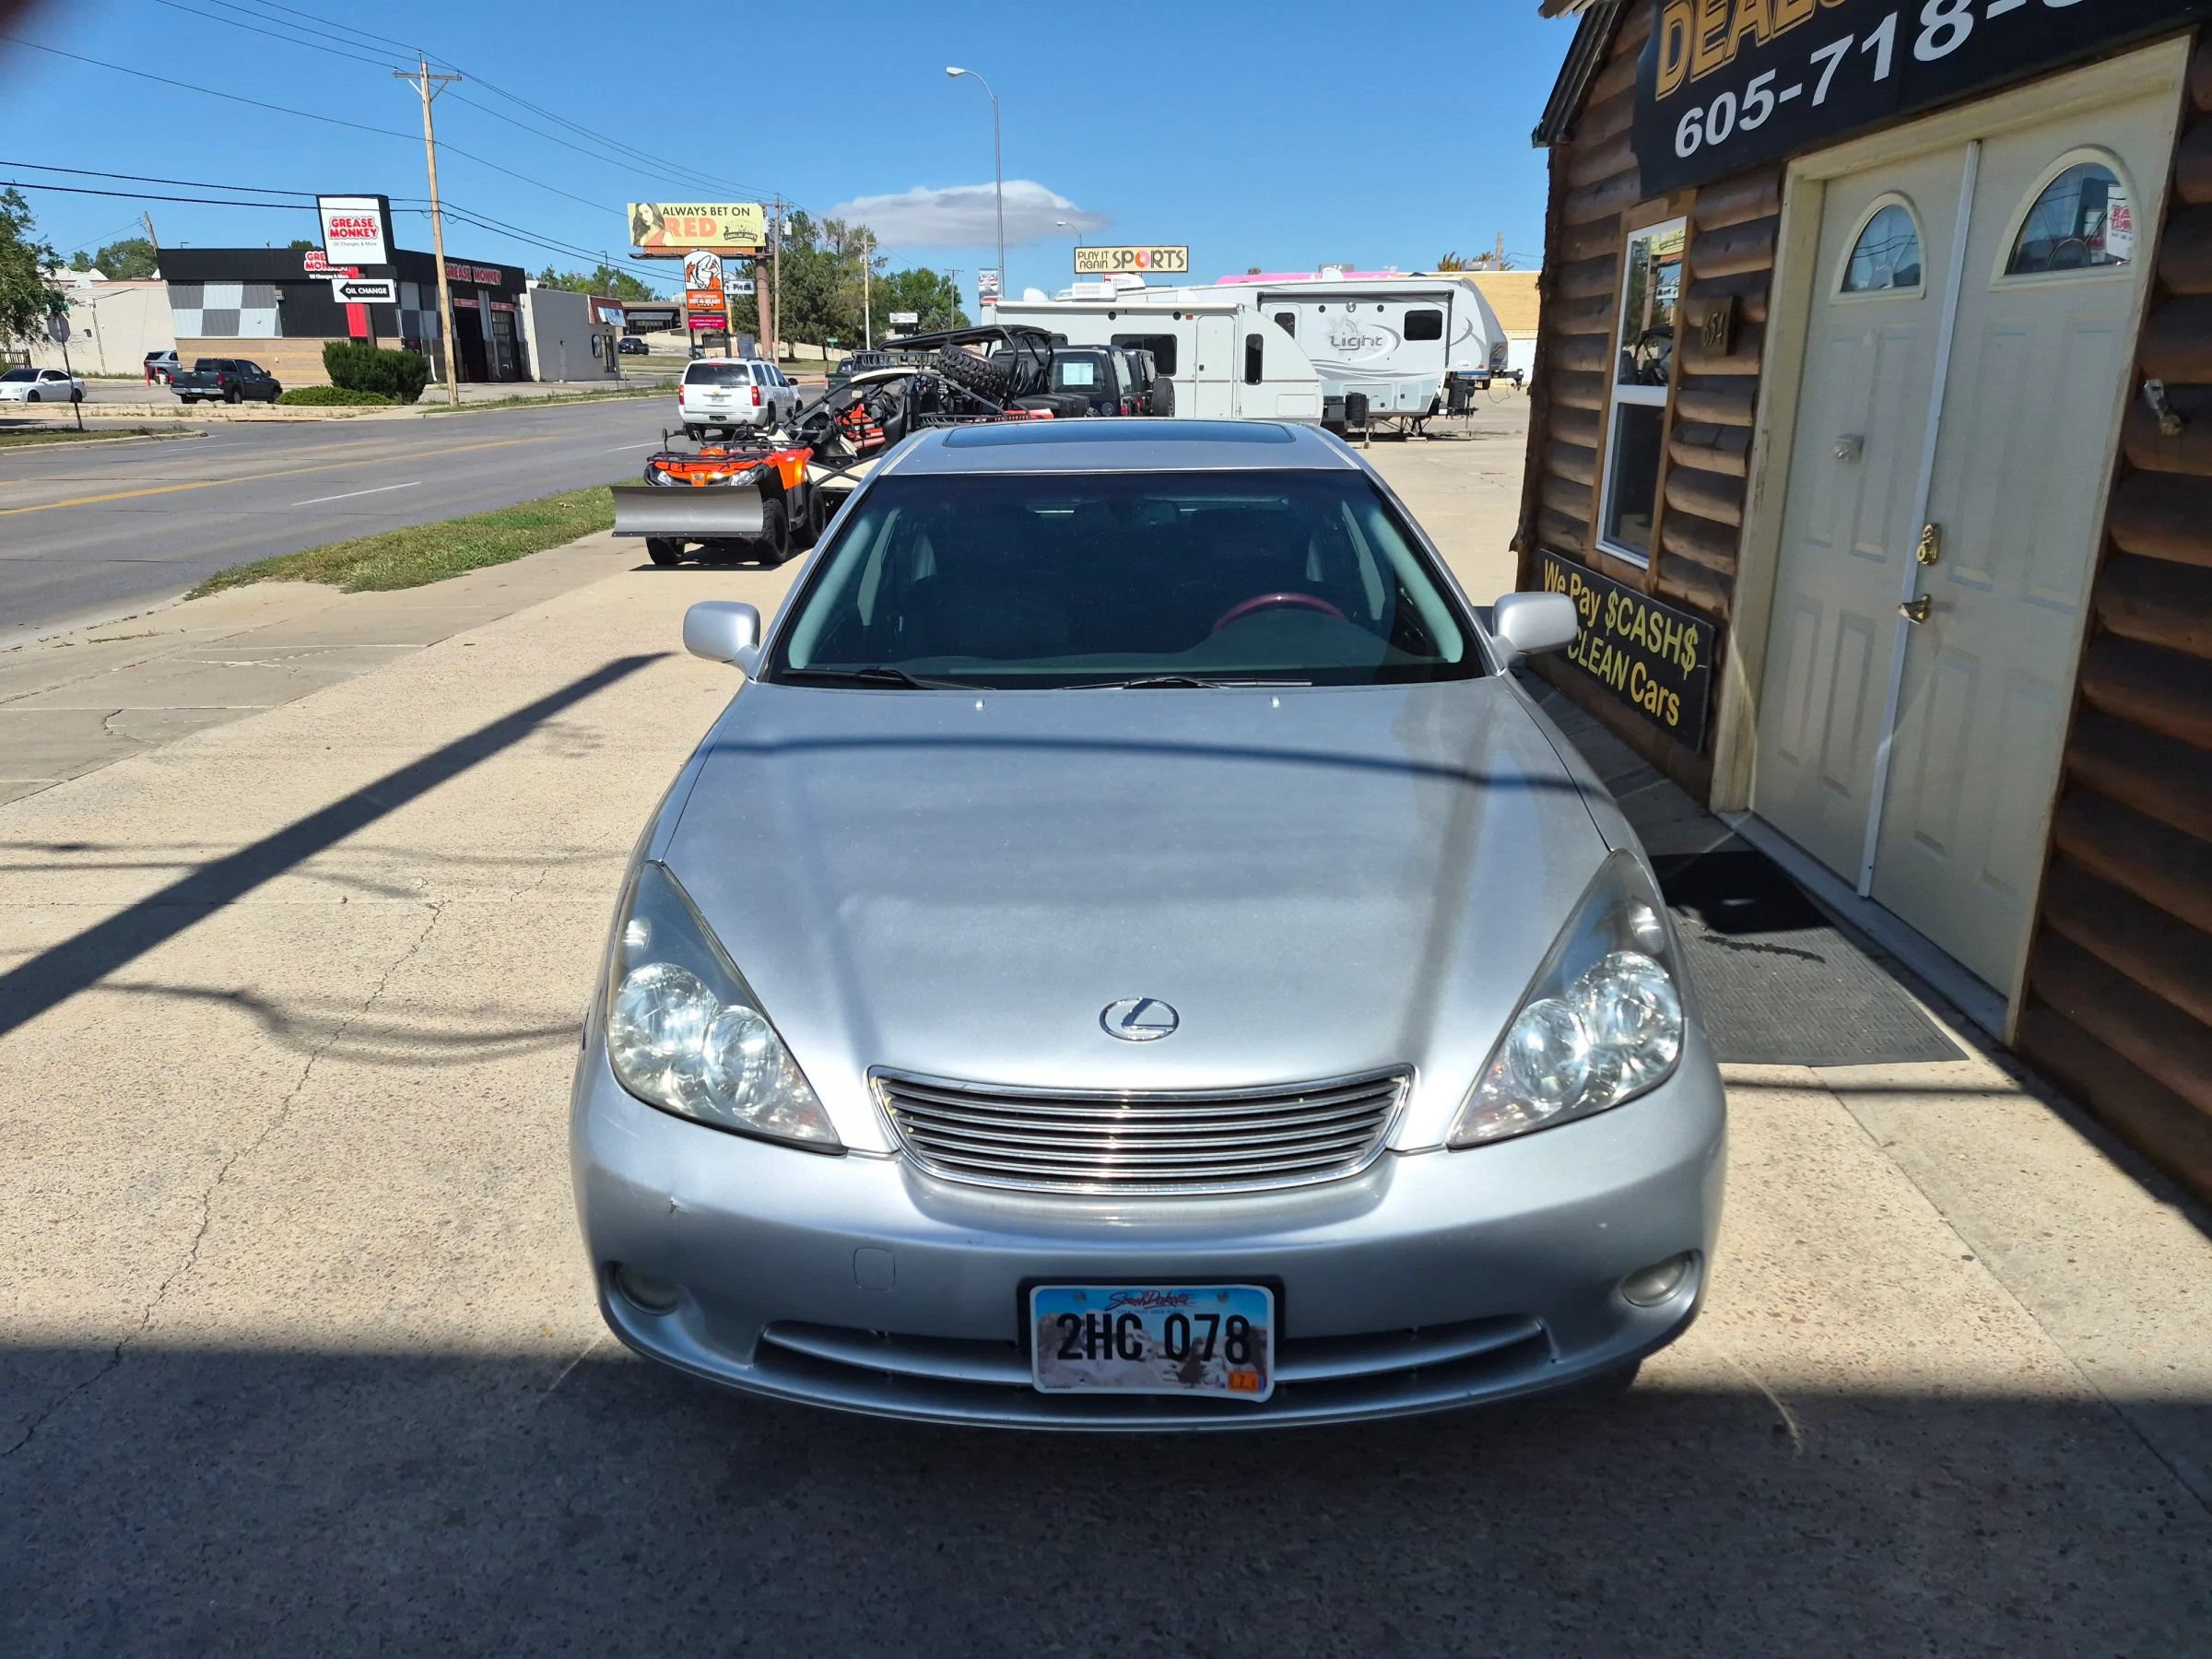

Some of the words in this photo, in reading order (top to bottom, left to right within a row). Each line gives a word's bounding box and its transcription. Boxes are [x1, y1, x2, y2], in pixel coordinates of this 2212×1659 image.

[1655, 0, 1845, 101] DEAL
[1674, 0, 2085, 159] 605-718-
[663, 206, 707, 216] ALWAYS
[711, 206, 727, 216] BET
[732, 207, 750, 217] ON
[331, 218, 374, 228] GREASE
[664, 217, 717, 237] RED
[329, 229, 378, 238] MONKEY
[1077, 251, 1100, 260] PLAY
[1100, 251, 1110, 260] IT
[1112, 250, 1185, 269] SPORTS
[1079, 260, 1109, 269] AGAIN
[445, 263, 472, 281] GREASE
[473, 266, 501, 285] MONKEY
[345, 286, 357, 294] OIL
[358, 286, 387, 294] CHANGE
[1330, 332, 1382, 350] Light
[1544, 559, 1566, 594] We
[1570, 572, 1601, 628] Pay
[1605, 587, 1699, 681] $CASH$
[1630, 661, 1680, 726] Cars
[1056, 1312, 1143, 1360] 2HC
[1163, 1313, 1250, 1365] 078
